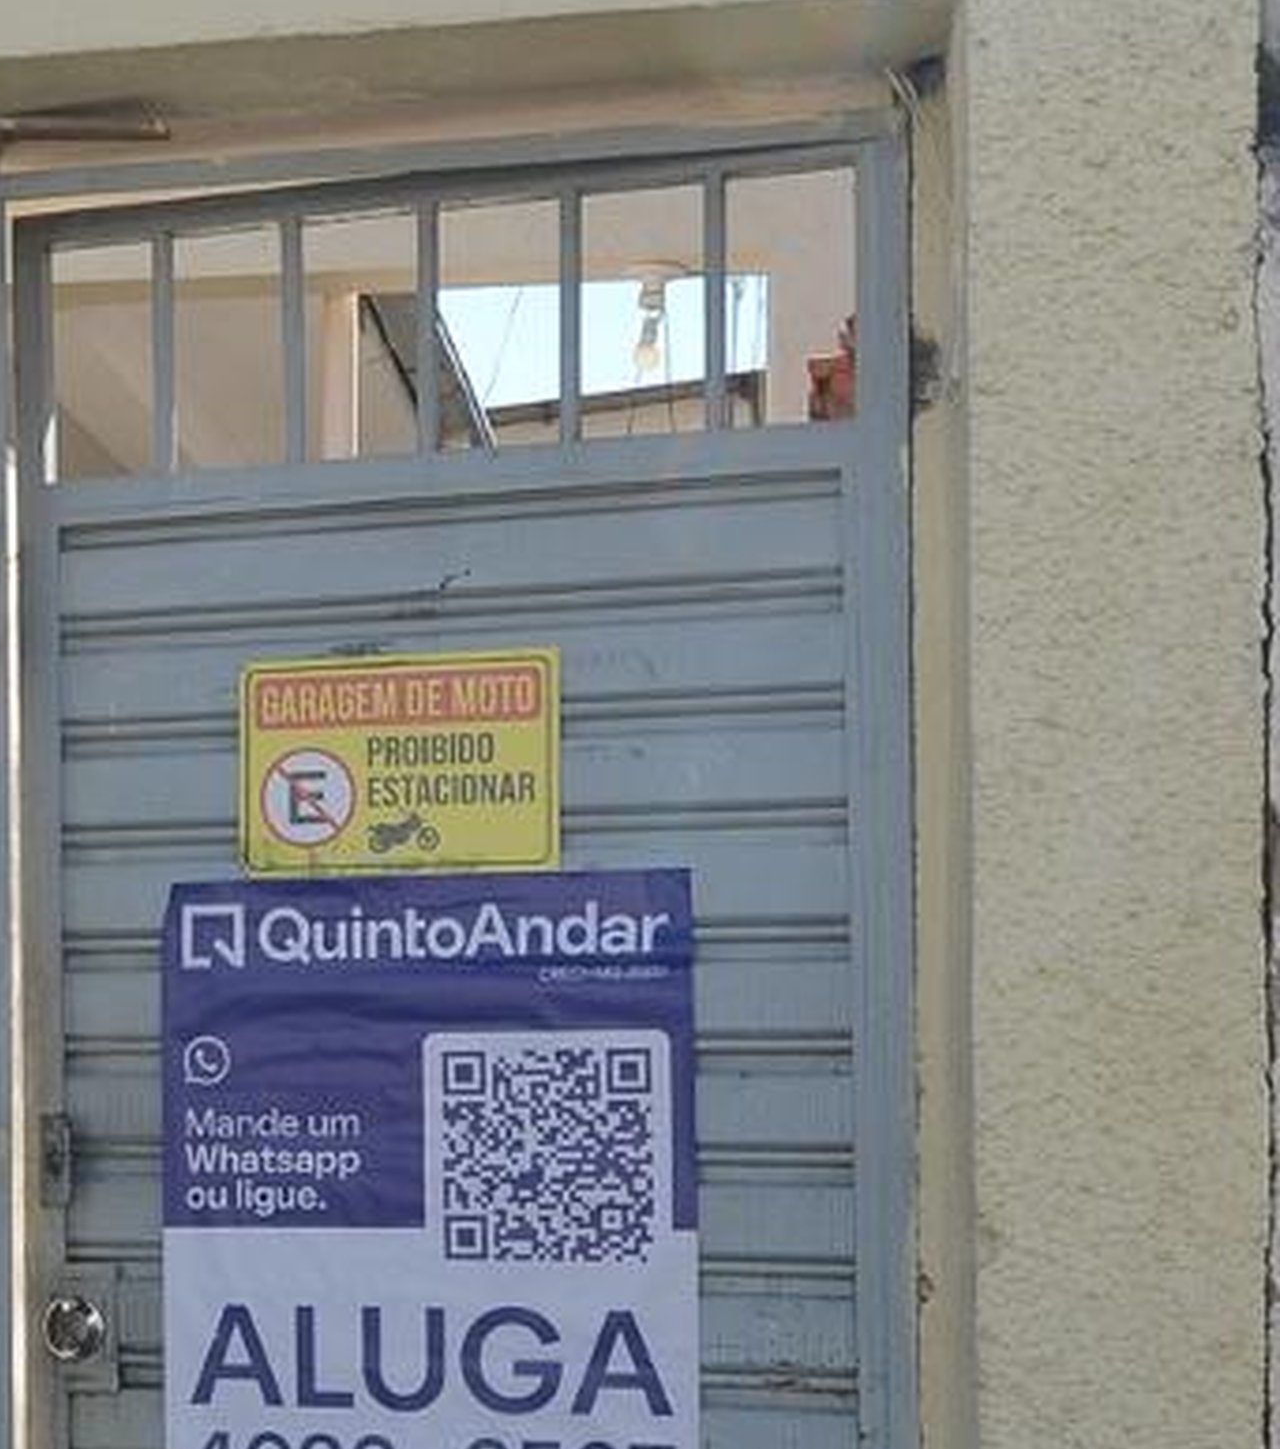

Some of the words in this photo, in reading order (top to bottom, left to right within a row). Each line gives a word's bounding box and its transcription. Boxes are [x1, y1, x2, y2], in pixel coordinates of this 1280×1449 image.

[261, 679, 397, 725] GARAGEM
[408, 678, 442, 717] DE
[451, 673, 534, 716] MOTO
[366, 731, 496, 768] PROIBIDO
[367, 771, 536, 808] ESTACIONAR
[257, 900, 670, 965] QuintoAndar
[184, 1107, 299, 1139] Mande
[307, 1112, 361, 1138] um
[184, 1143, 362, 1180] Whatsapp
[185, 1187, 228, 1210] ou
[236, 1179, 327, 1216] ligue.
[190, 1303, 674, 1417] ALUGA
